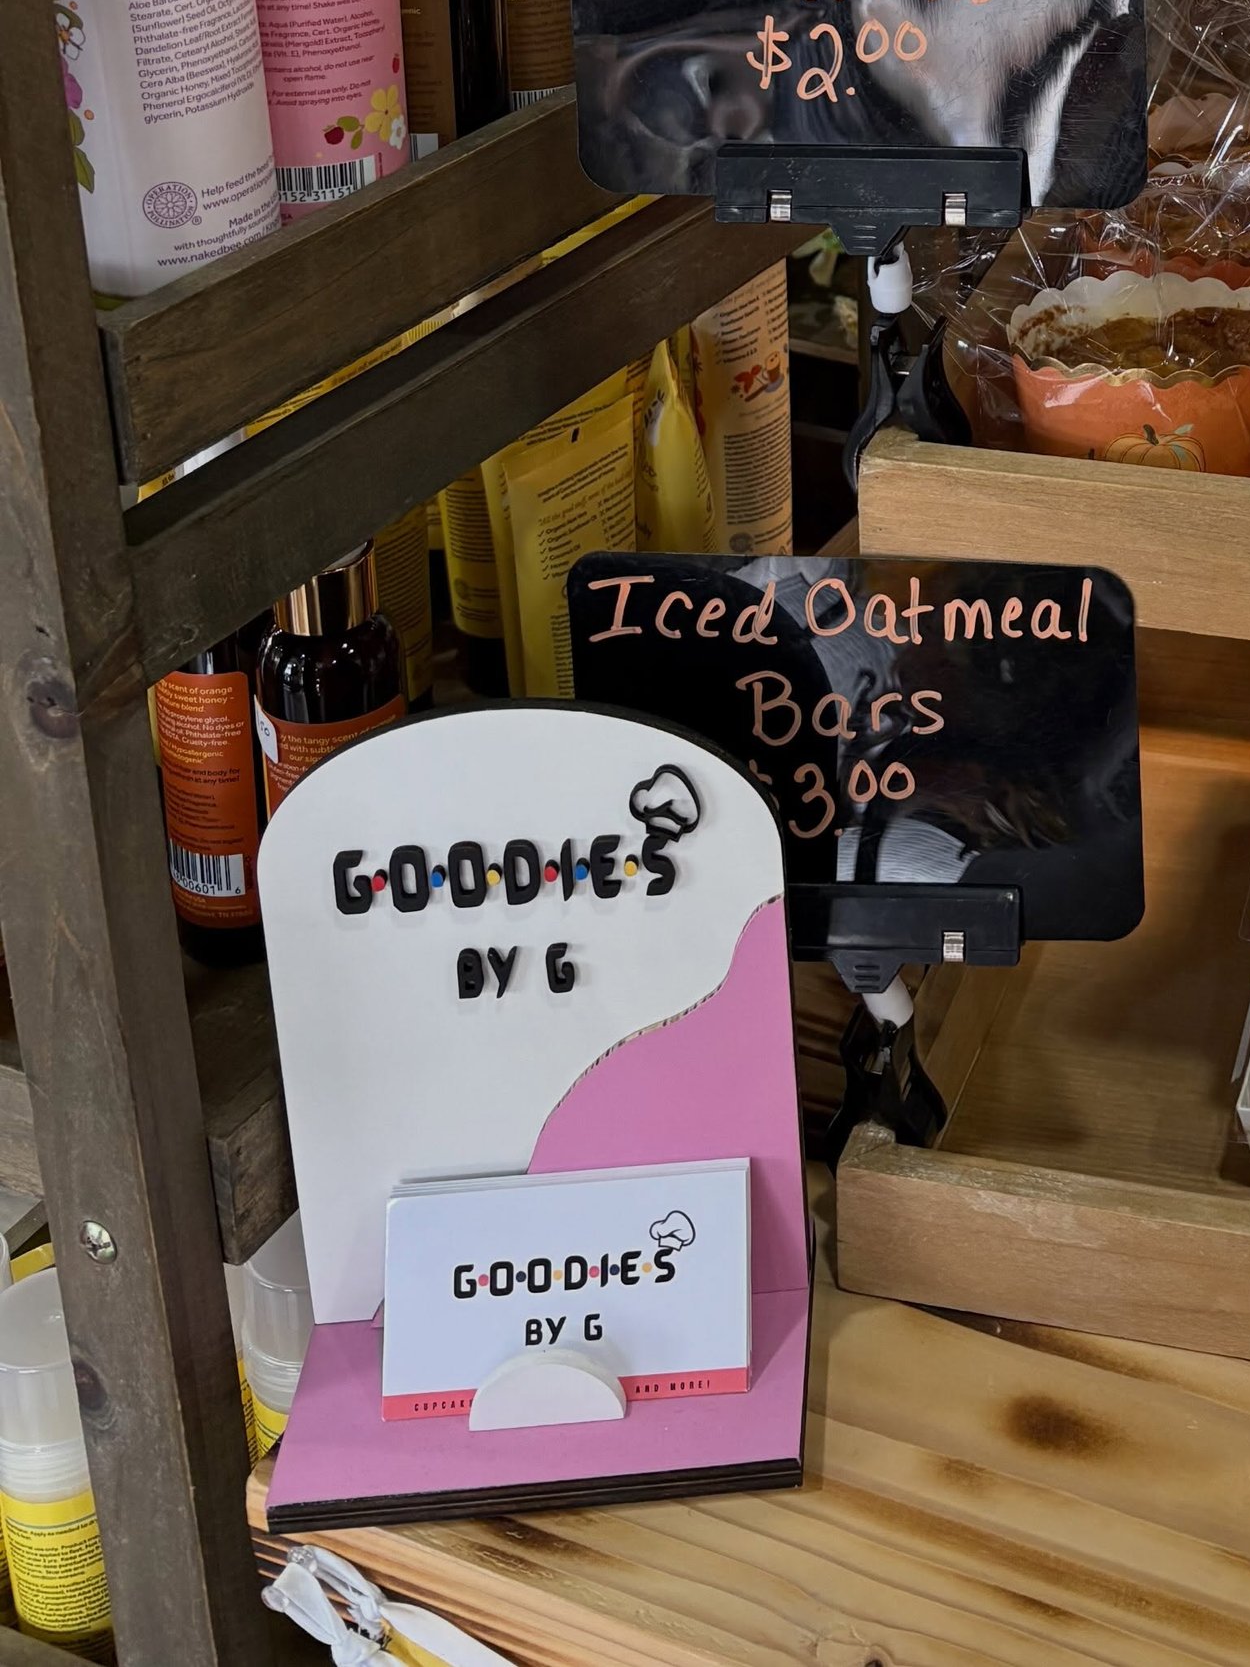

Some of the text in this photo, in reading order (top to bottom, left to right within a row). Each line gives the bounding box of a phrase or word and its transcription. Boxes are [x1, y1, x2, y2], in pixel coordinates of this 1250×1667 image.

[135, 38, 183, 55] Dandelion
[747, 15, 927, 102] $2.00
[141, 89, 179, 100] Organic
[147, 184, 193, 205] OPERATION
[201, 175, 245, 198] Help feed
[229, 214, 253, 228] Made
[158, 233, 262, 267] www.nakedbee.com
[174, 242, 195, 252] with
[588, 575, 1093, 647] Iced Oatmeal
[199, 696, 227, 704] honey
[200, 687, 232, 695] orange
[735, 670, 945, 746] Bars
[288, 735, 330, 745] the tangy
[457, 942, 576, 999] BY G
[524, 1313, 603, 1347] BY G
[635, 1383, 660, 1394] AND
[670, 1379, 711, 1392] MORE!
